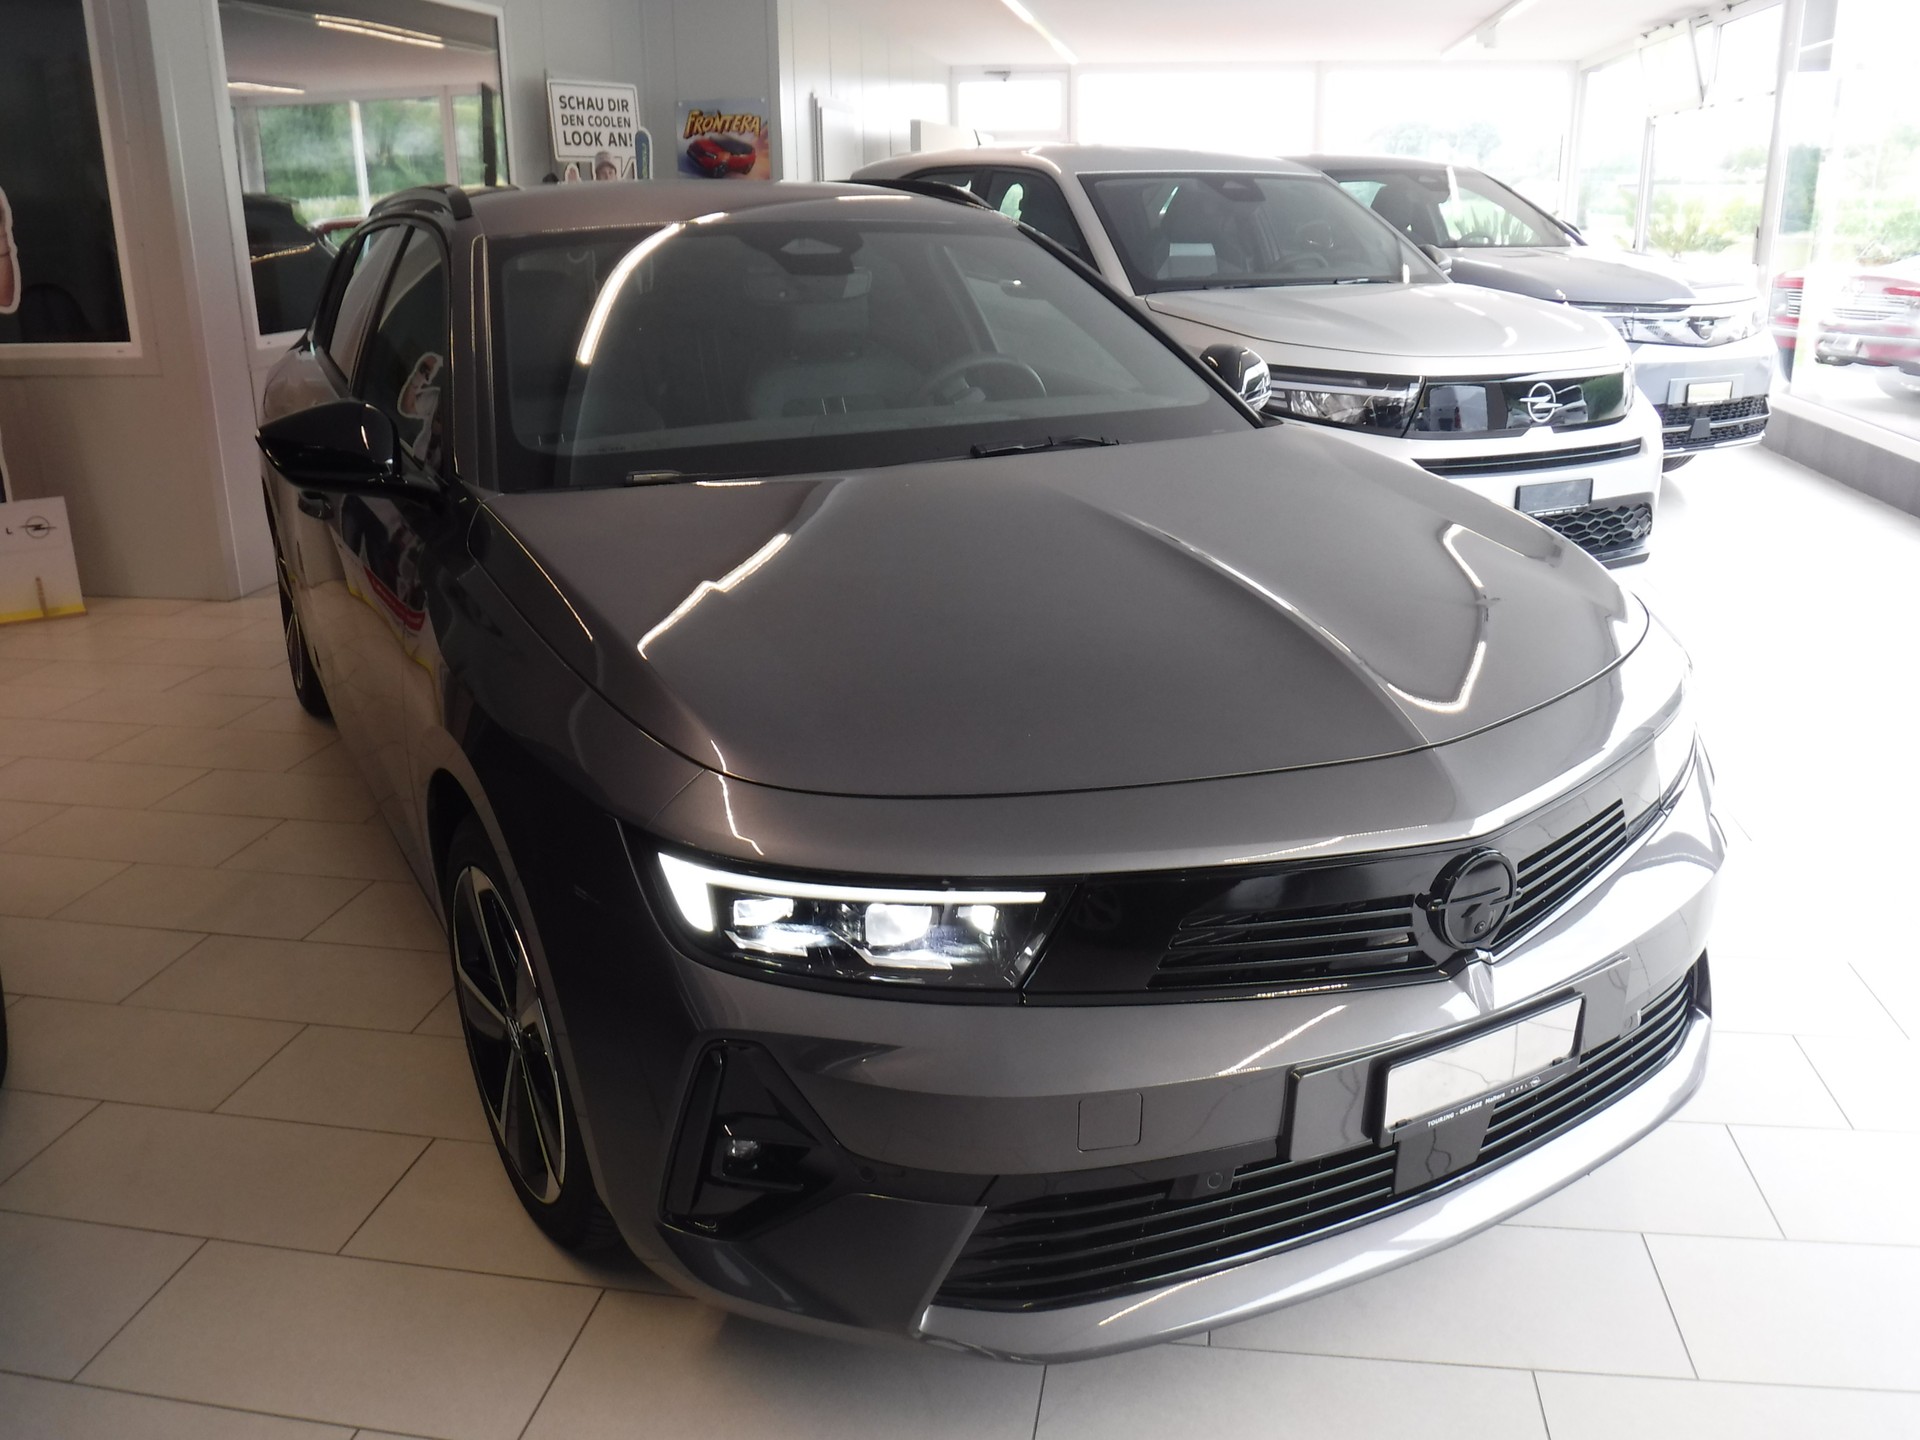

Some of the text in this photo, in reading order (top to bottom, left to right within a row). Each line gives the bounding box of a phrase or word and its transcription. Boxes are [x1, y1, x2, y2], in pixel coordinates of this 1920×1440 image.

[559, 95, 629, 112] SCHAU DIR
[561, 114, 631, 128] DEN COOLEN
[683, 109, 761, 139] FRONTERA
[563, 130, 633, 147] LOOK AN!
[1427, 1112, 1455, 1127] TOURING
[1459, 1101, 1482, 1115] GARAGE
